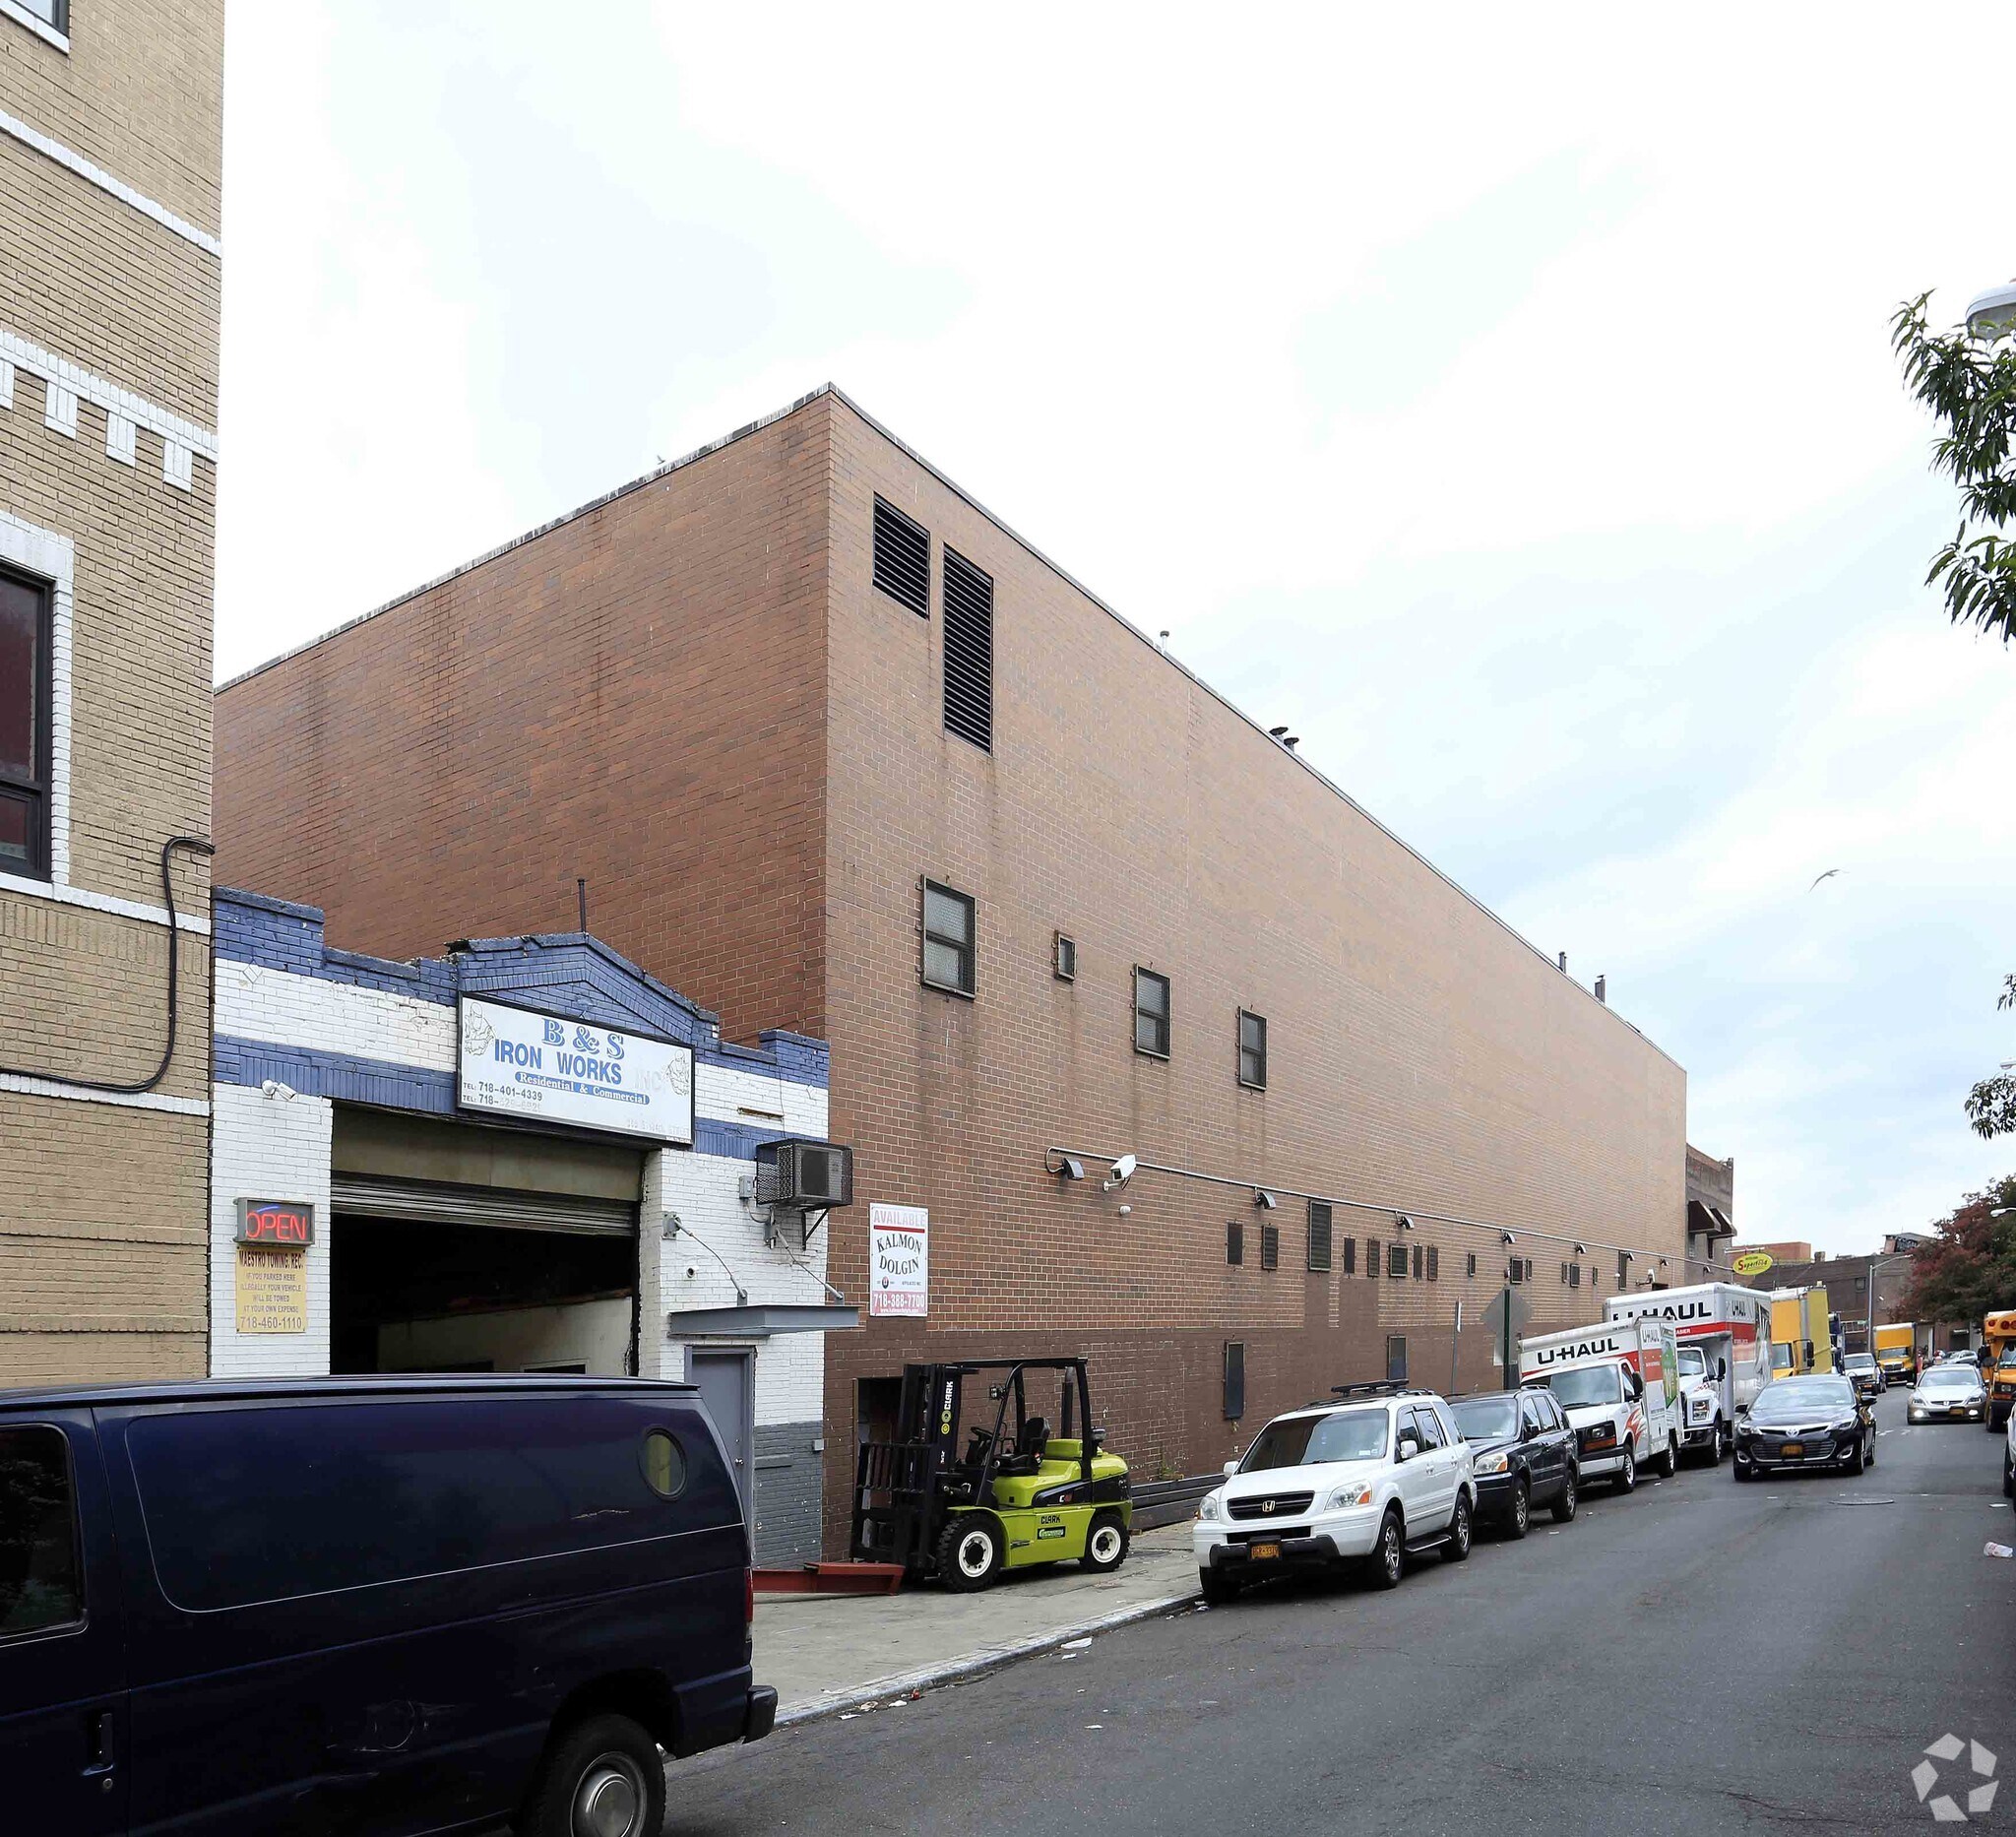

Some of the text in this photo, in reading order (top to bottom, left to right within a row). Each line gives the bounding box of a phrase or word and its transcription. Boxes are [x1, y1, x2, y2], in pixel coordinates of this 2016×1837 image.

[542, 1018, 625, 1060] B & S
[494, 1038, 542, 1069] IRON
[556, 1051, 622, 1085] WORKS
[463, 1081, 543, 1102] TEL: 718-401-4339
[519, 1072, 647, 1105] Residential & Commercial
[246, 1211, 306, 1239] OPEN
[873, 1209, 925, 1227] AVAILABLE
[876, 1233, 922, 1255] KALMON
[239, 1250, 266, 1268] MAESTRO
[879, 1254, 919, 1276] DOLGIN
[241, 1283, 267, 1292] ILLEGALLY
[873, 1294, 925, 1308] 718-388-7700
[240, 1316, 303, 1329] 718-460-1110
[1538, 1338, 1620, 1365] U-HAUL
[943, 1380, 954, 1411] CLARK
[1040, 1514, 1061, 1525] CLARK
